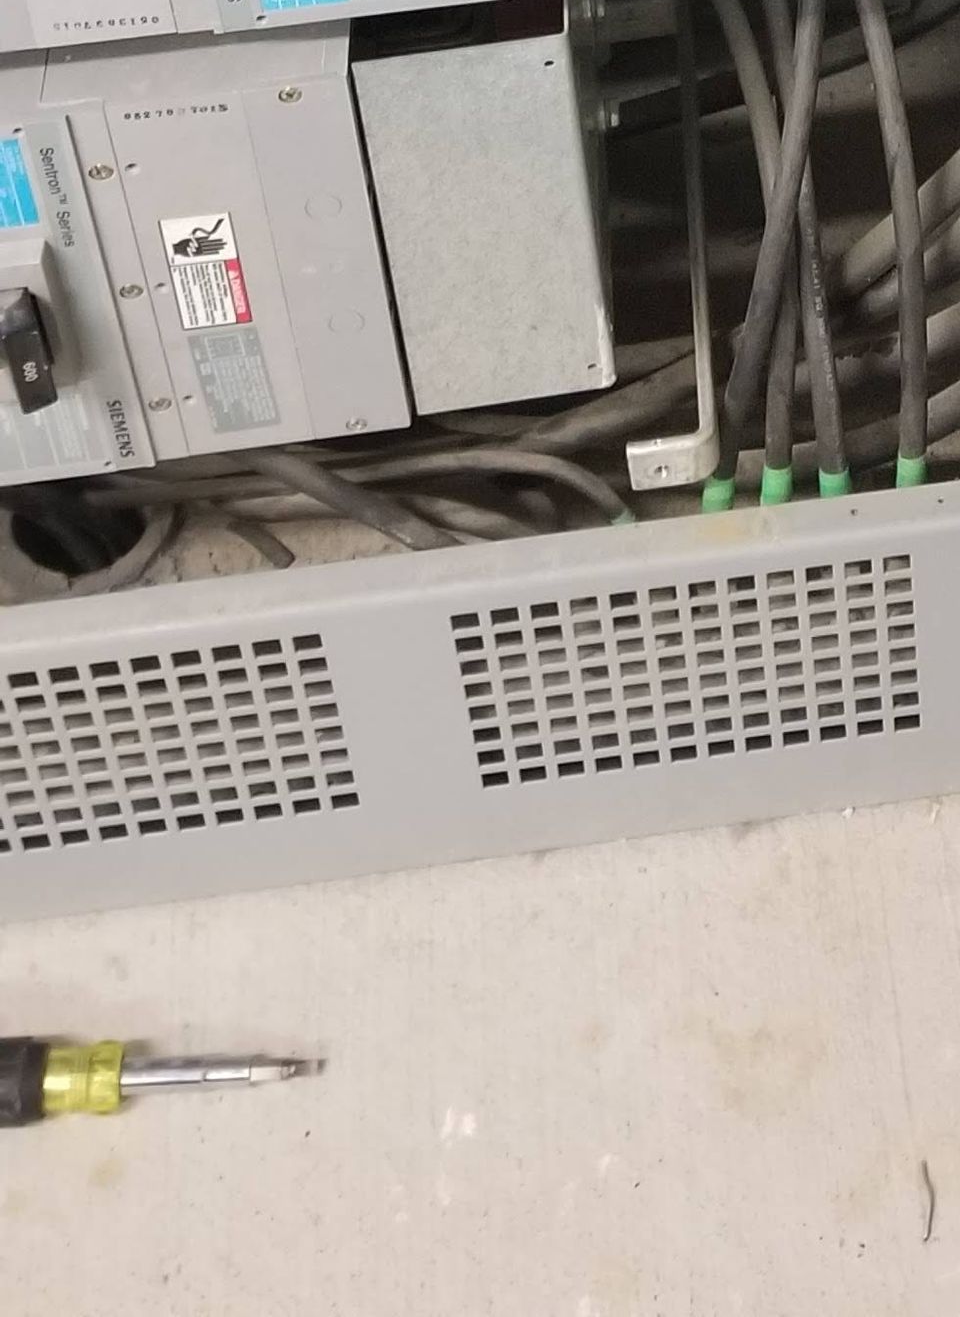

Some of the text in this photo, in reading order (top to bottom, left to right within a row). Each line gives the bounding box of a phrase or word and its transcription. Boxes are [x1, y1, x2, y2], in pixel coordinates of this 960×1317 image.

[56, 211, 75, 247] Series
[23, 361, 38, 382] 600
[107, 400, 135, 458] SIEMENS
